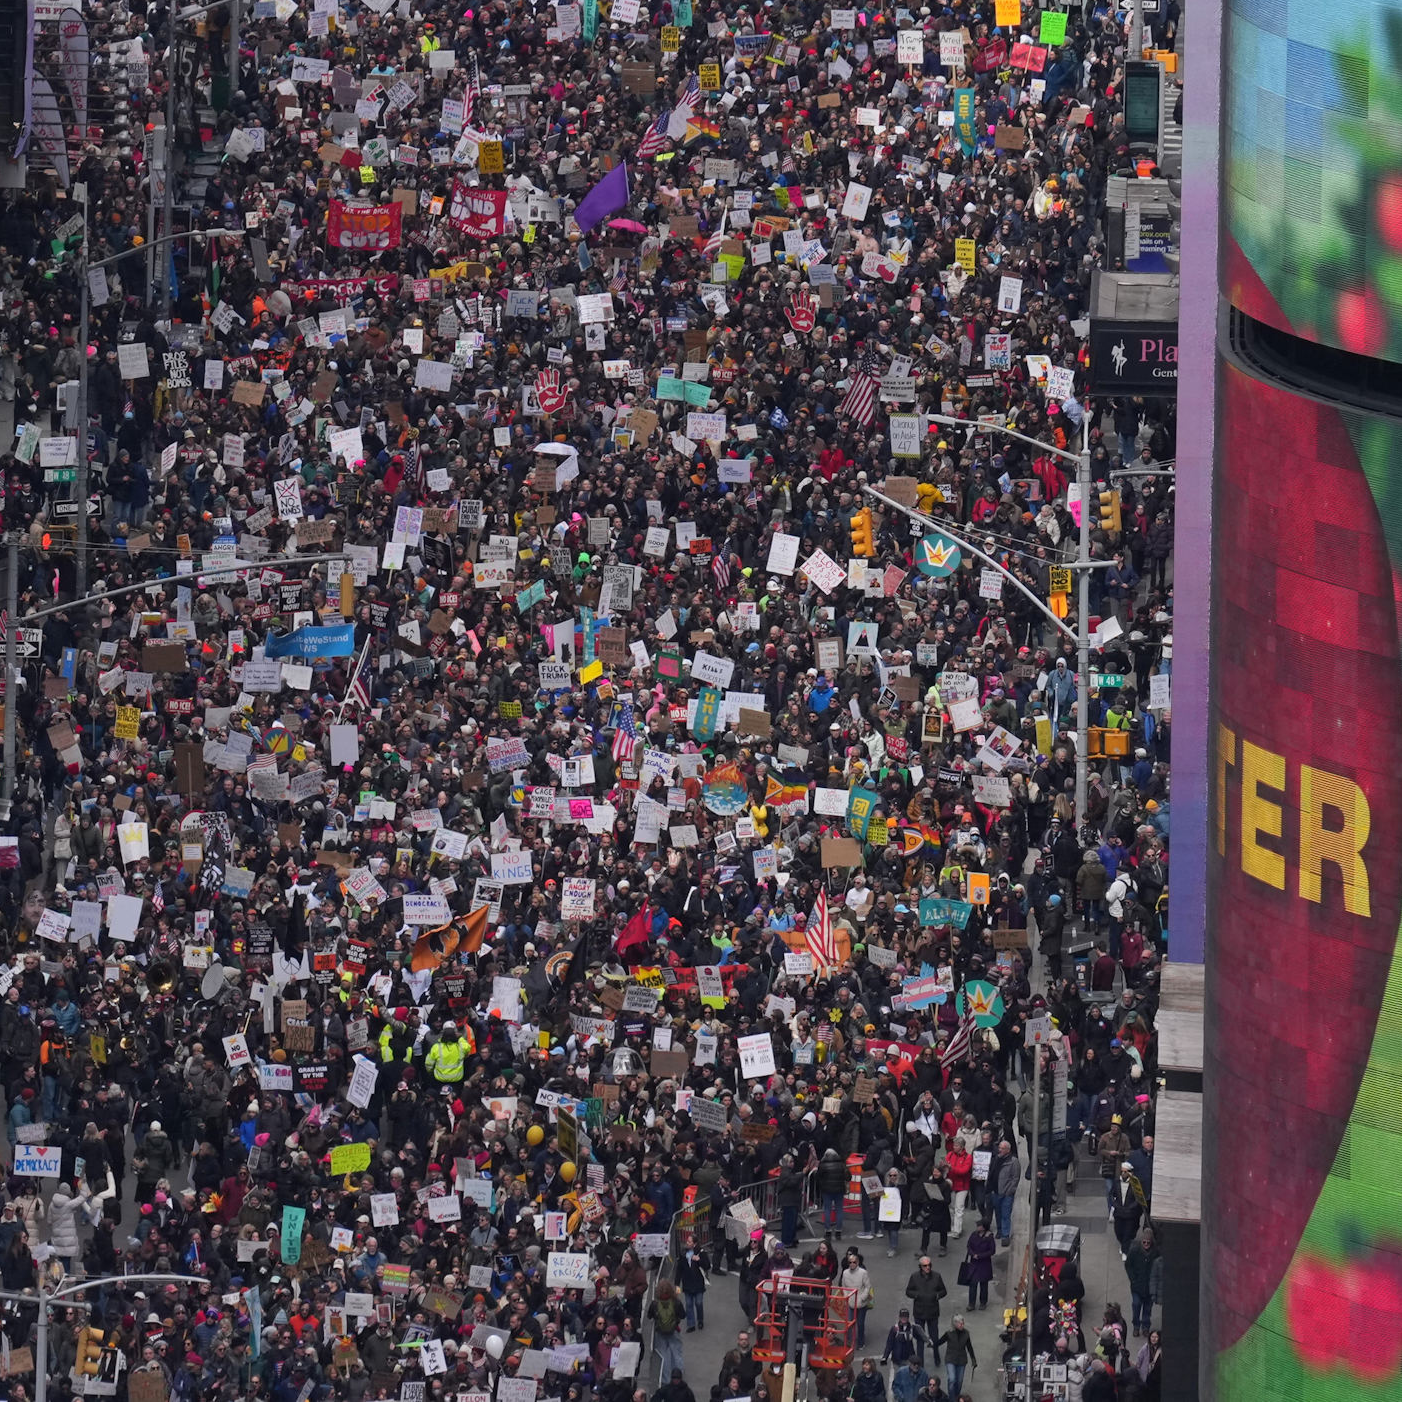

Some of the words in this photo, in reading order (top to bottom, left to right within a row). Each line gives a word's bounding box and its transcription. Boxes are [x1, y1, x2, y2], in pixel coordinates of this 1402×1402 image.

[900, 34, 923, 43] Trump
[178, 45, 197, 76] 15
[342, 215, 391, 232] STOP
[339, 230, 390, 248] CUTS
[513, 307, 531, 315] ICE
[1139, 339, 1178, 363] Pla
[162, 351, 186, 362] DROP
[164, 360, 188, 370] FILES
[170, 370, 186, 379] NOT
[713, 370, 721, 378] NO
[167, 378, 192, 389] BOMBS
[897, 440, 912, 453] 47
[58, 503, 72, 513] ONE
[281, 498, 295, 508] NO
[280, 507, 301, 516] KINGS
[283, 603, 300, 611] NOW!
[370, 603, 389, 611] TRUMP
[542, 665, 565, 673] FUCK
[1105, 677, 1115, 686] 48
[169, 701, 179, 709] NO
[179, 701, 191, 709] ICE!
[502, 854, 520, 864] NO
[493, 864, 532, 879] KINGS
[350, 875, 369, 891] BIG
[563, 890, 591, 898] ENOUGH
[445, 979, 465, 987] TRUMP
[229, 1050, 248, 1060] KINGS
[23, 1147, 31, 1156] I
[15, 1159, 59, 1172] DEMOCRACY
[288, 1214, 298, 1263] UNITED
[553, 1257, 587, 1269] RESIST
